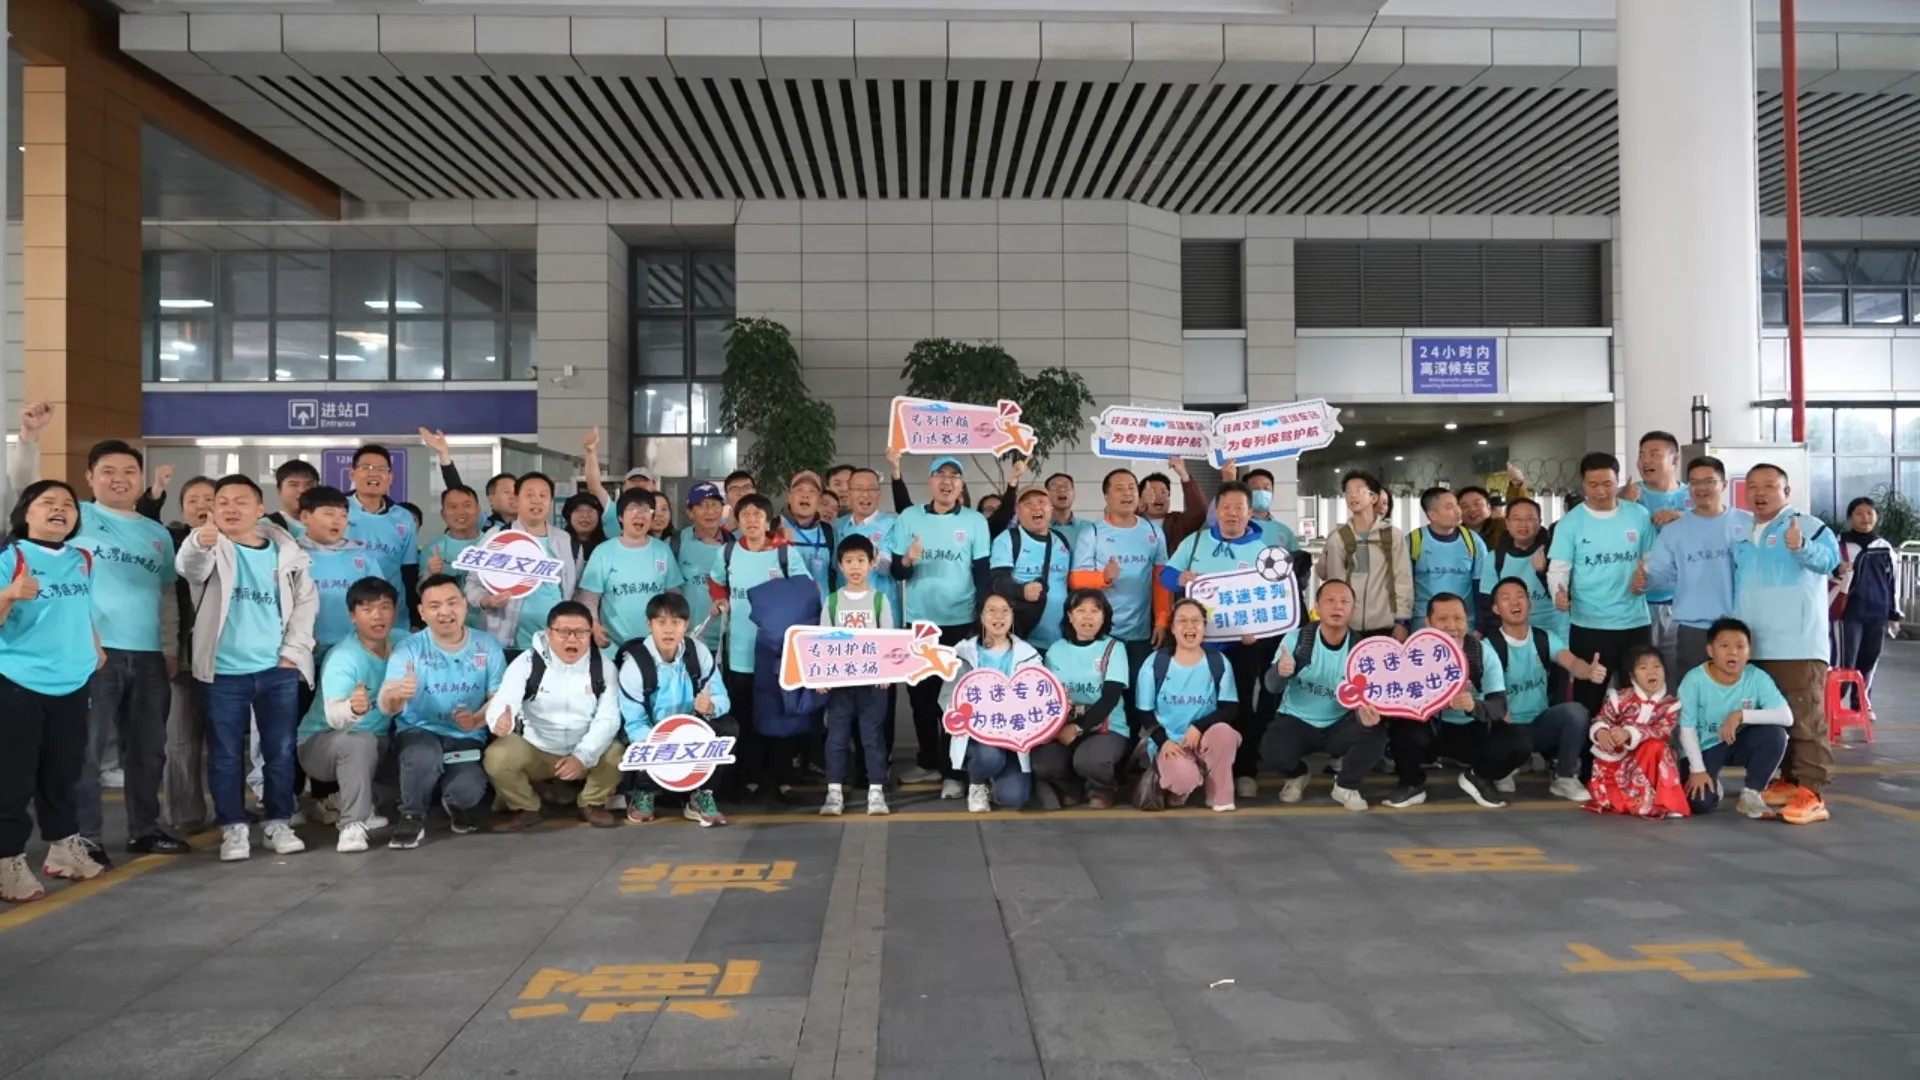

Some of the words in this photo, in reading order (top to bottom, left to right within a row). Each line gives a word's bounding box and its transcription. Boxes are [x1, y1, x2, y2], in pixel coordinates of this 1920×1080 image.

[1420, 345, 1490, 359] 24小时内
[321, 402, 369, 418] 进站口
[320, 420, 356, 428] Entrance
[1111, 432, 1203, 448] 为专列保驾护航
[1227, 425, 1320, 452] 为专列保驾护航
[460, 548, 560, 576] 铁青文旅
[1218, 583, 1287, 606] 球迷专列
[1358, 644, 1451, 676] 球迷专列
[966, 679, 1052, 704] 球迷专列
[1367, 663, 1461, 700] 为热爱出发
[972, 699, 1062, 731] 为热爱出发
[628, 740, 731, 763] 铁青文旅
